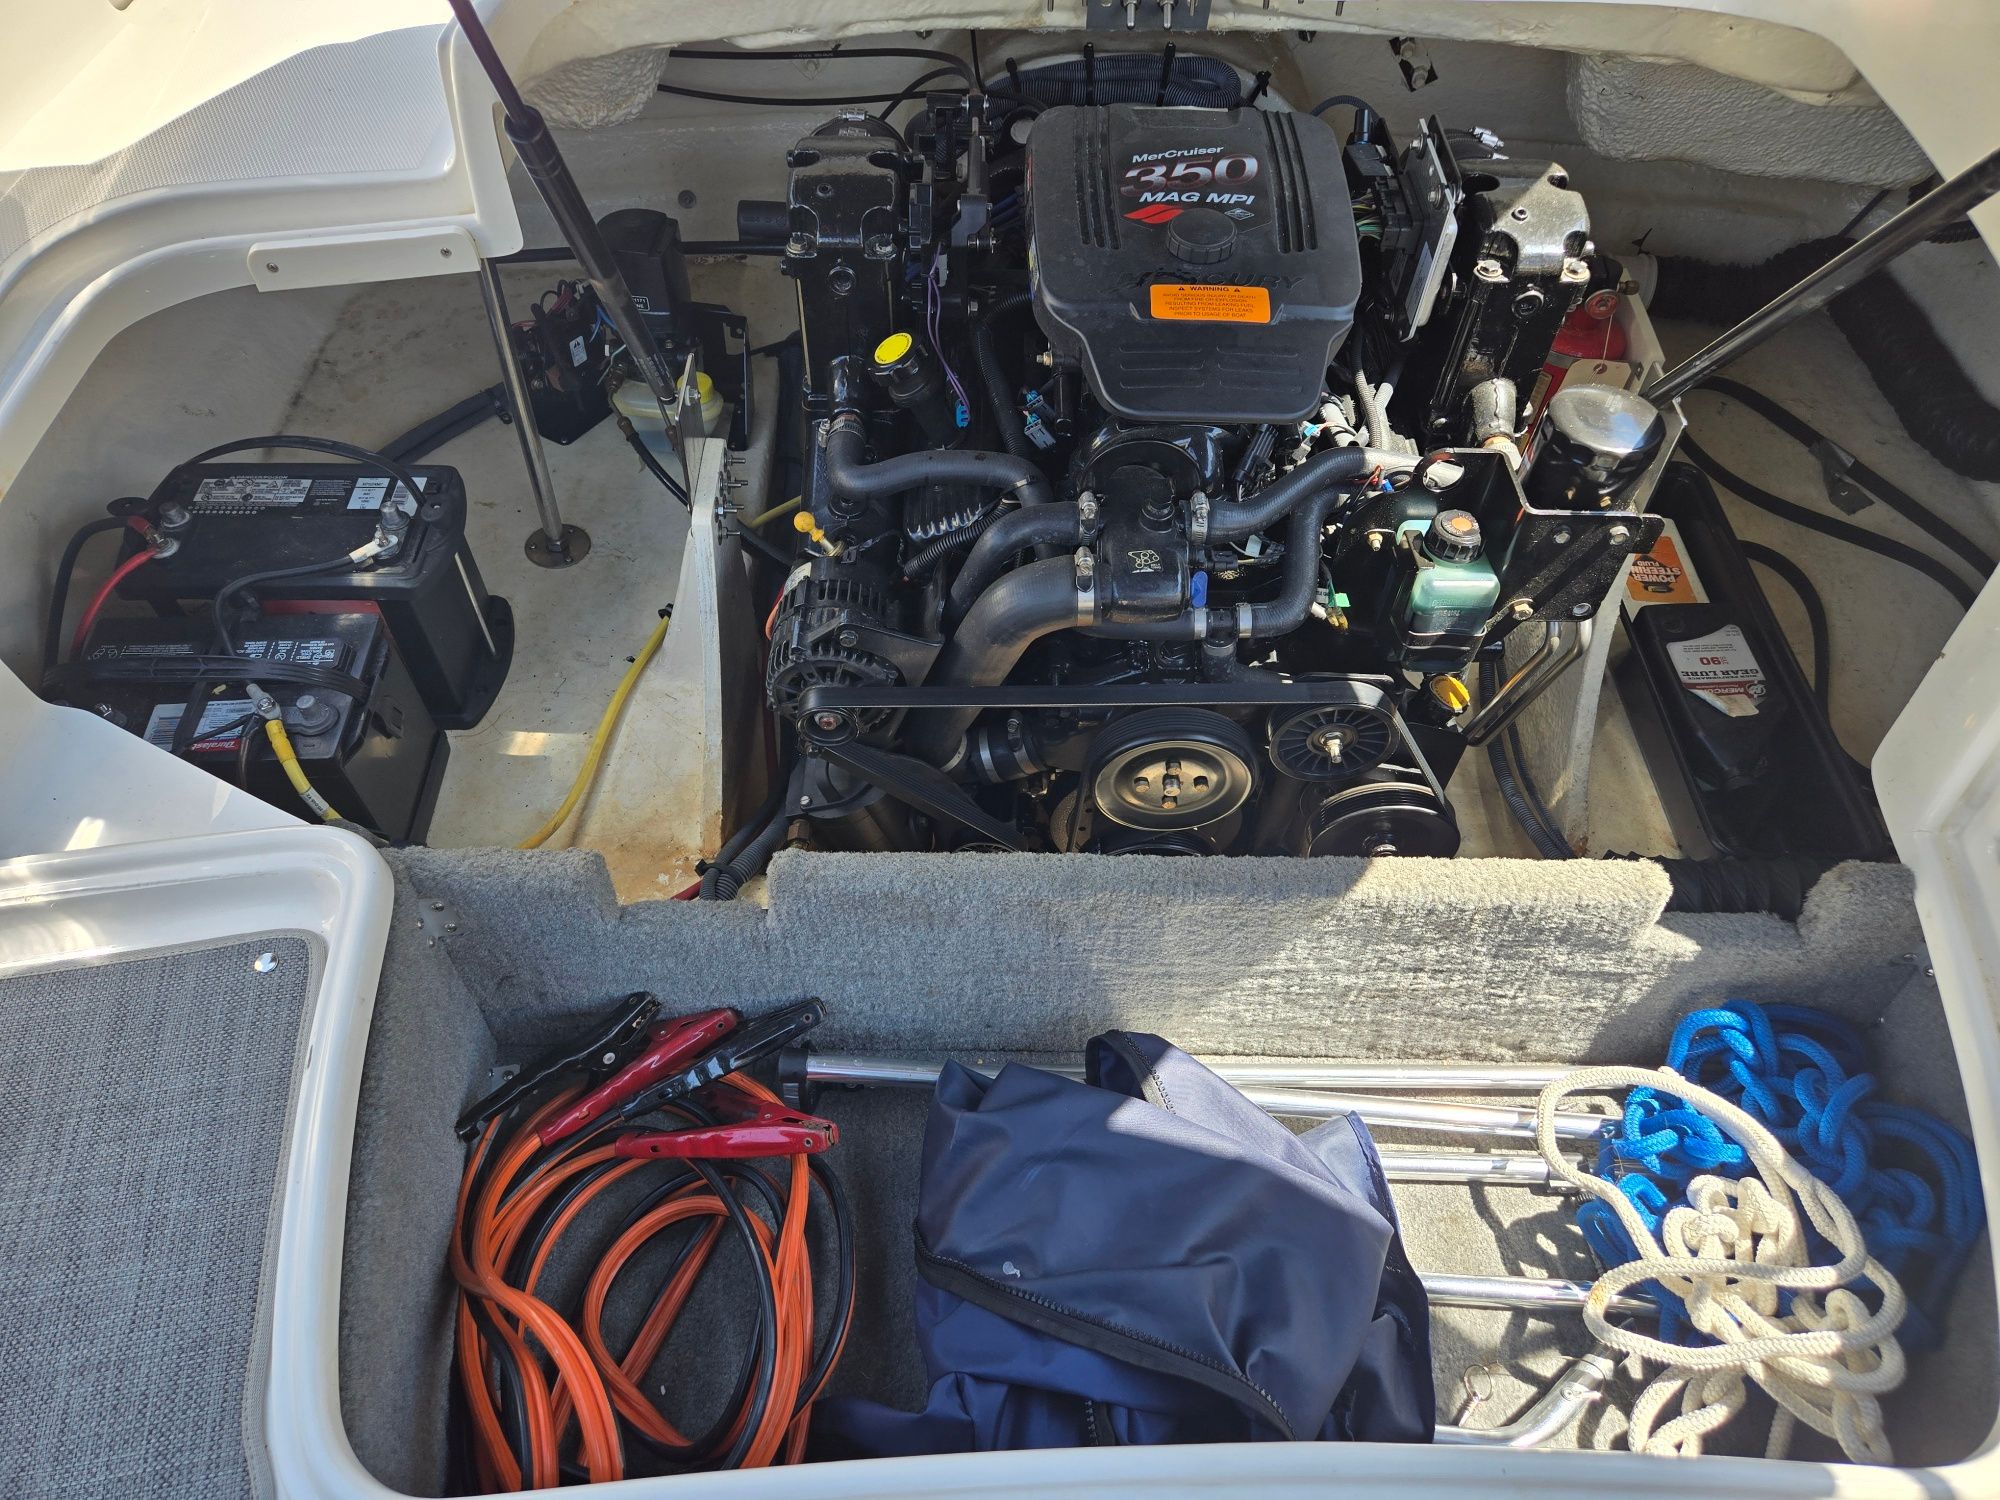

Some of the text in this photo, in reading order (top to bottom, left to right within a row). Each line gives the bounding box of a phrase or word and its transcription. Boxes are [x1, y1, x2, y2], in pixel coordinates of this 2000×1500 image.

[1132, 146, 1224, 163] MerCruiser
[1120, 153, 1259, 197] 350
[1139, 191, 1256, 205] MAG MPI
[1631, 566, 1681, 576] STEERIN
[1633, 574, 1676, 583] POWER
[1699, 656, 1721, 666] 90
[1720, 668, 1759, 676] GEAR
[192, 741, 235, 751] Duralast
